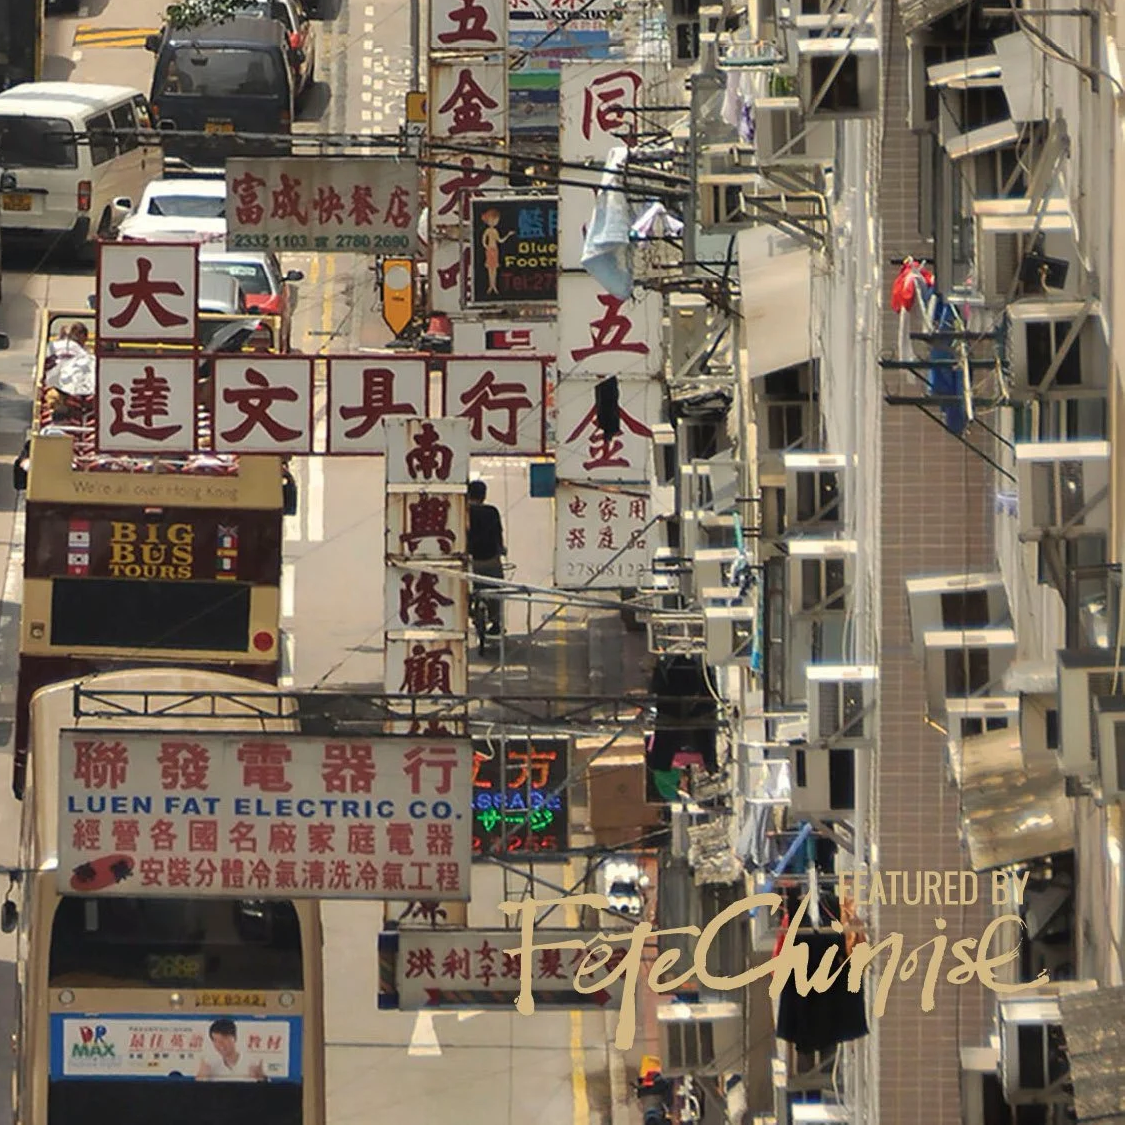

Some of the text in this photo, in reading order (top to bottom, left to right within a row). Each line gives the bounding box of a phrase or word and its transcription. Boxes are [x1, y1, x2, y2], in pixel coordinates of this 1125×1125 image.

[234, 233, 270, 249] 2332
[274, 233, 308, 249] 1103
[110, 520, 196, 544] BIG
[110, 542, 195, 565] BUS
[108, 563, 194, 580] TOURS
[72, 740, 459, 795] 聯發電器行
[67, 795, 463, 820] LUEN FAT ELECTRIC CO.
[72, 820, 455, 857] 經營各國名廠家庭電器
[139, 856, 461, 892] 安裝分體冷氣清洗冷氣工程
